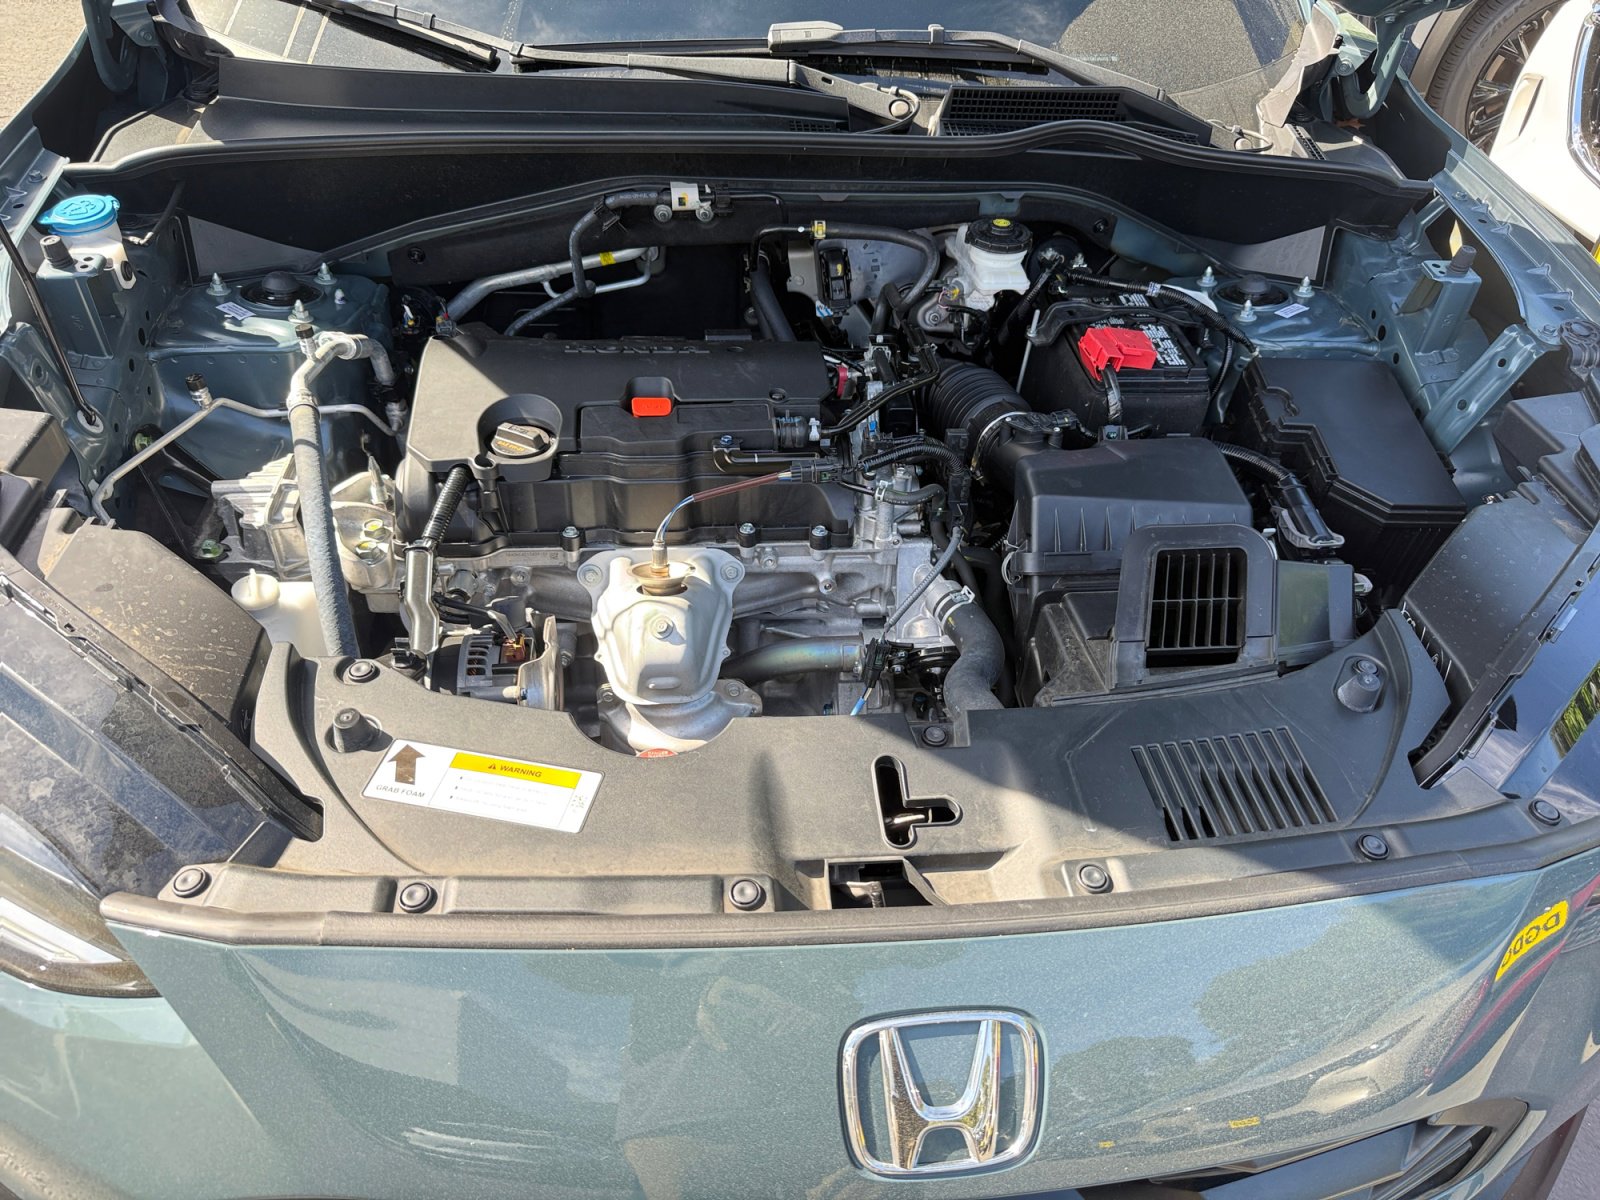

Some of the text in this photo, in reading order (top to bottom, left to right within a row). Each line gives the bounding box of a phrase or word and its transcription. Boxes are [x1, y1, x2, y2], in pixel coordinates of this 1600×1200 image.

[499, 765, 542, 778] WARNING
[375, 784, 426, 798] GRAB FOAM
